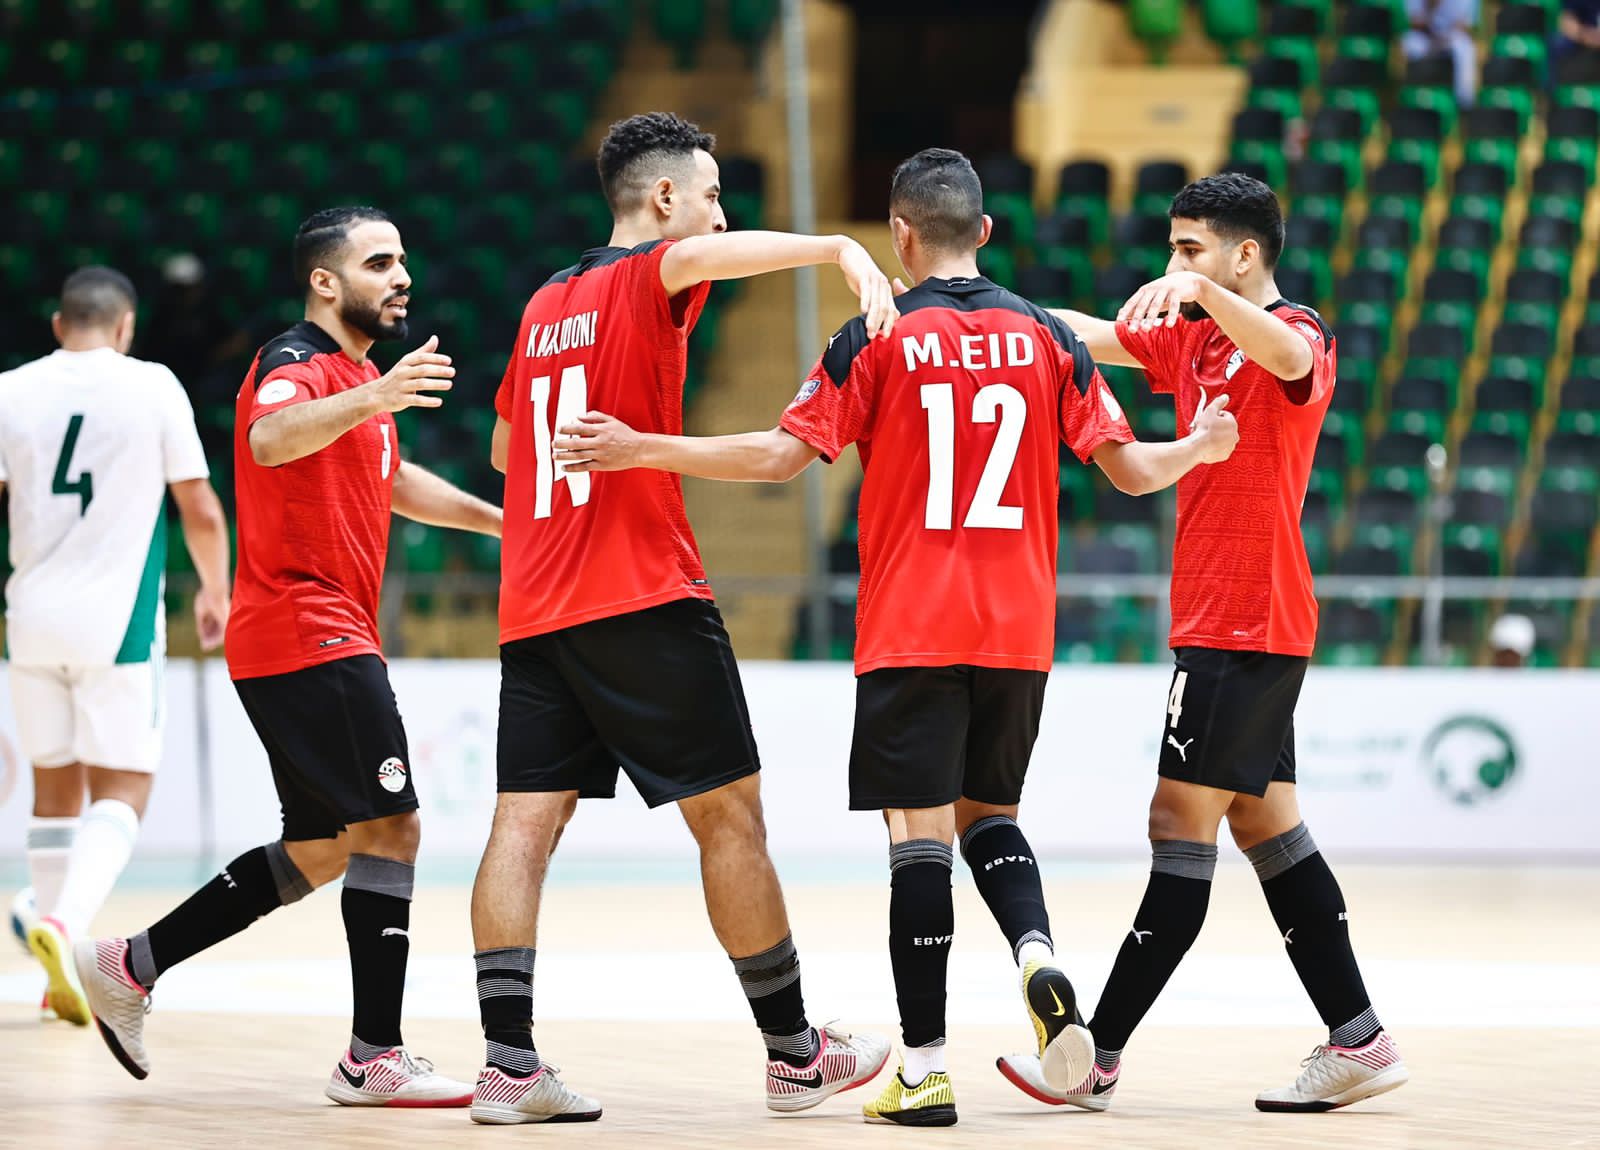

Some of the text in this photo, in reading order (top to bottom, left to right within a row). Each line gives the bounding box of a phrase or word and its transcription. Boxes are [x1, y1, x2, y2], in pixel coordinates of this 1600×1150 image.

[901, 331, 1035, 372] M.EID
[52, 415, 93, 517] 4
[529, 363, 592, 521] 14
[919, 382, 1028, 531] 12
[1167, 671, 1188, 728] 4
[984, 855, 1033, 871] EGYPT
[913, 934, 953, 946] EGYP
